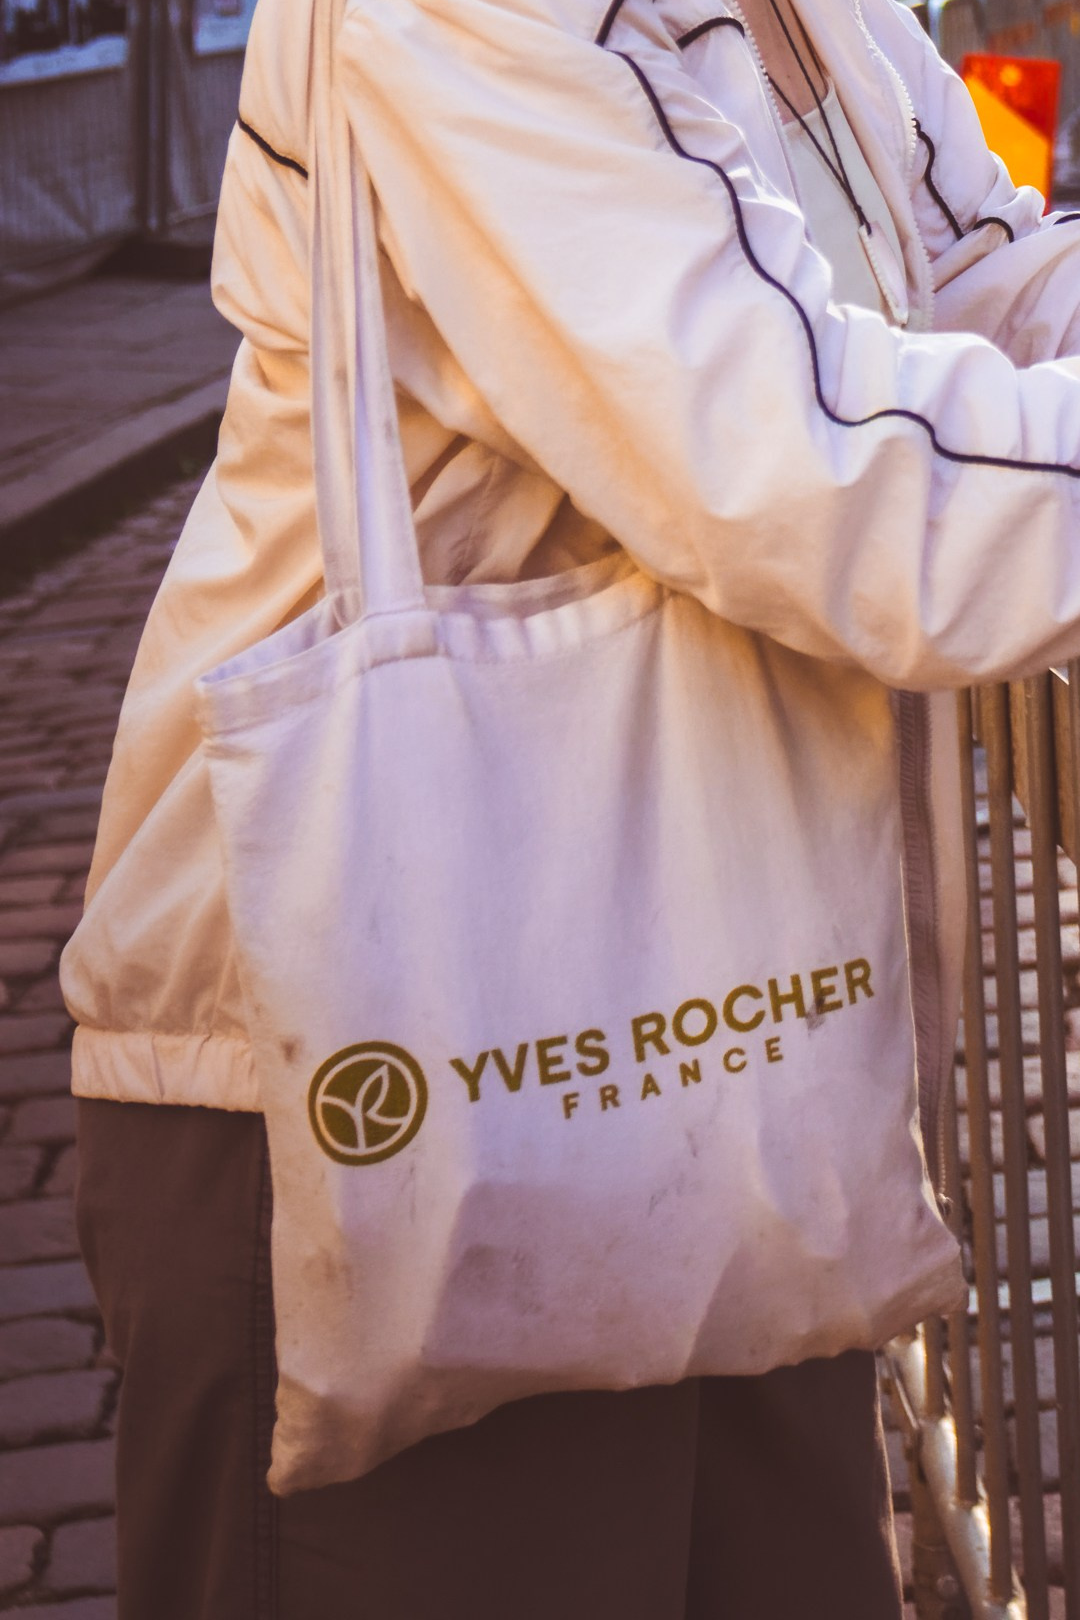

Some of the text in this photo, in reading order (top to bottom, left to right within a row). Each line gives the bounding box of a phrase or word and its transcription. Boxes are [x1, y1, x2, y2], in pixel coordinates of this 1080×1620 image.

[449, 957, 875, 1103] YVES ROCHER
[562, 1036, 783, 1119] FRANCE
